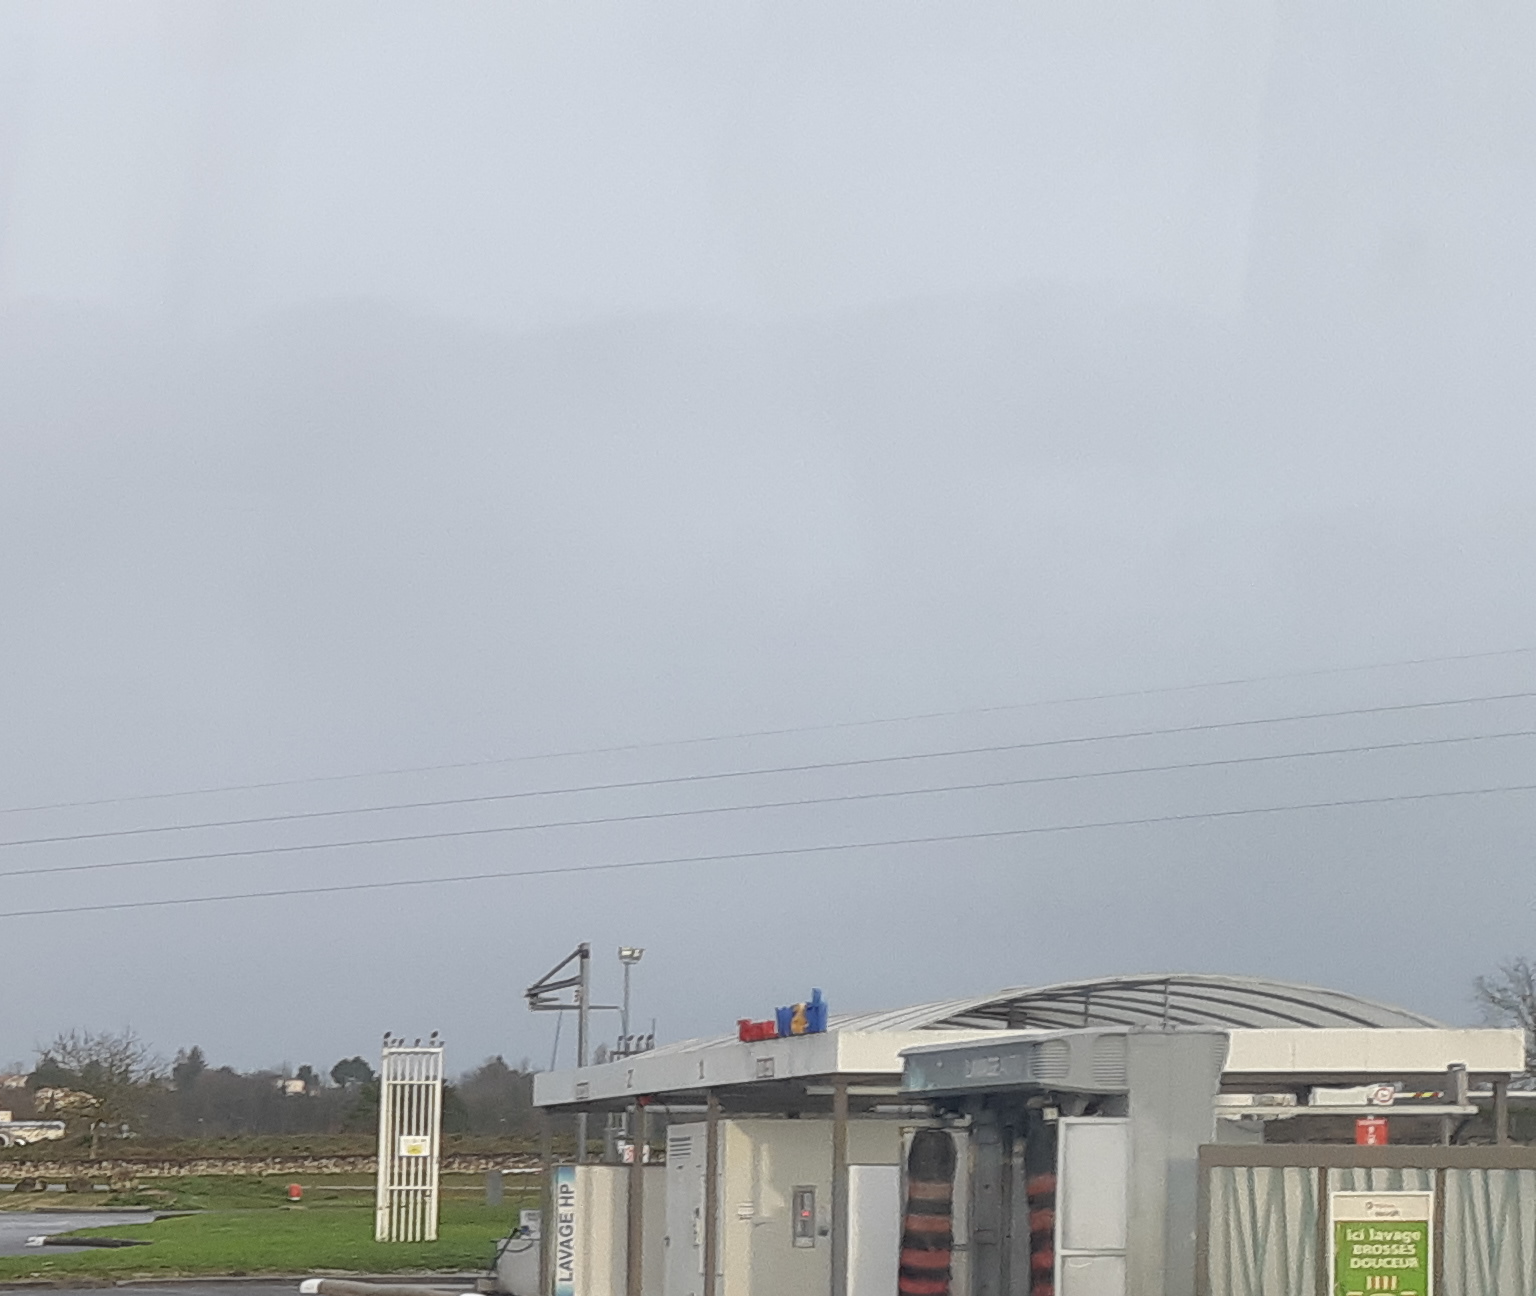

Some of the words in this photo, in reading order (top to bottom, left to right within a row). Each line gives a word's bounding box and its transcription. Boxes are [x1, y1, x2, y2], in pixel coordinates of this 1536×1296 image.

[559, 1183, 575, 1207] HP
[558, 1212, 574, 1282] LAVAGE
[1352, 1244, 1417, 1255] BROSSES
[1349, 1257, 1420, 1269] DOUCEUR
